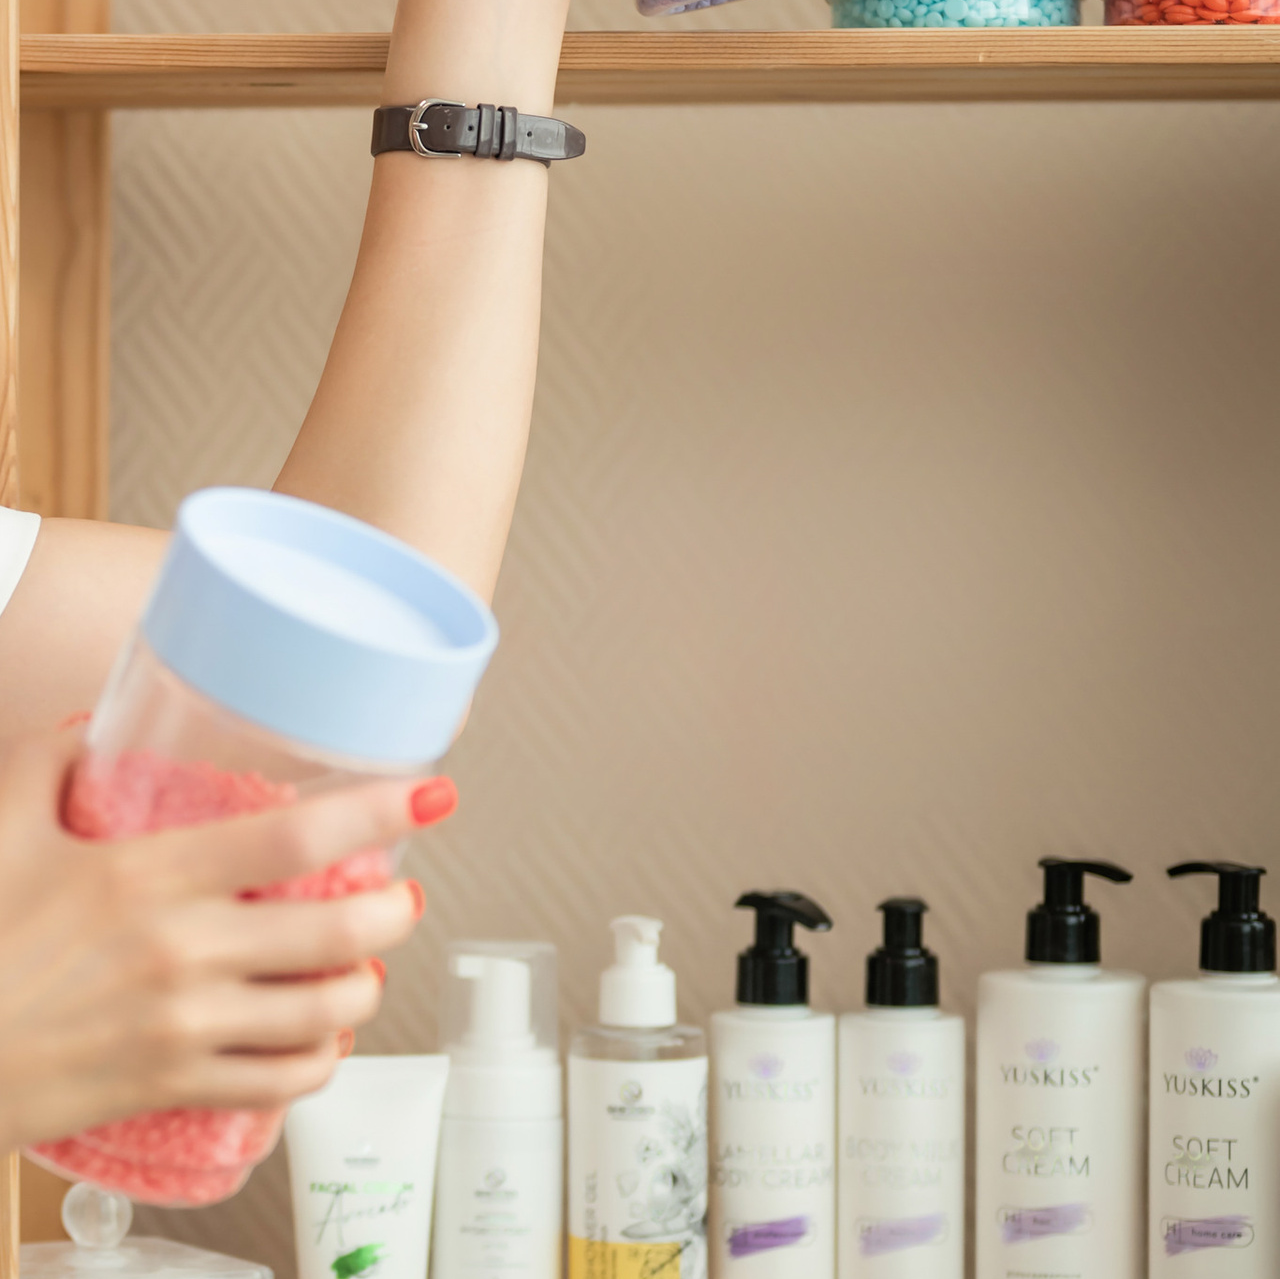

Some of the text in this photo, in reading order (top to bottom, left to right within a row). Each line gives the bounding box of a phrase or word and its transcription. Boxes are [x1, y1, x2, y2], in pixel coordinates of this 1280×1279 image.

[1162, 1072, 1252, 1099] YUSKISS
[1011, 1125, 1080, 1151] SOFT
[1172, 1134, 1238, 1162] SOFT
[1001, 1152, 1091, 1178] CREAM
[1164, 1160, 1249, 1190] CREAM
